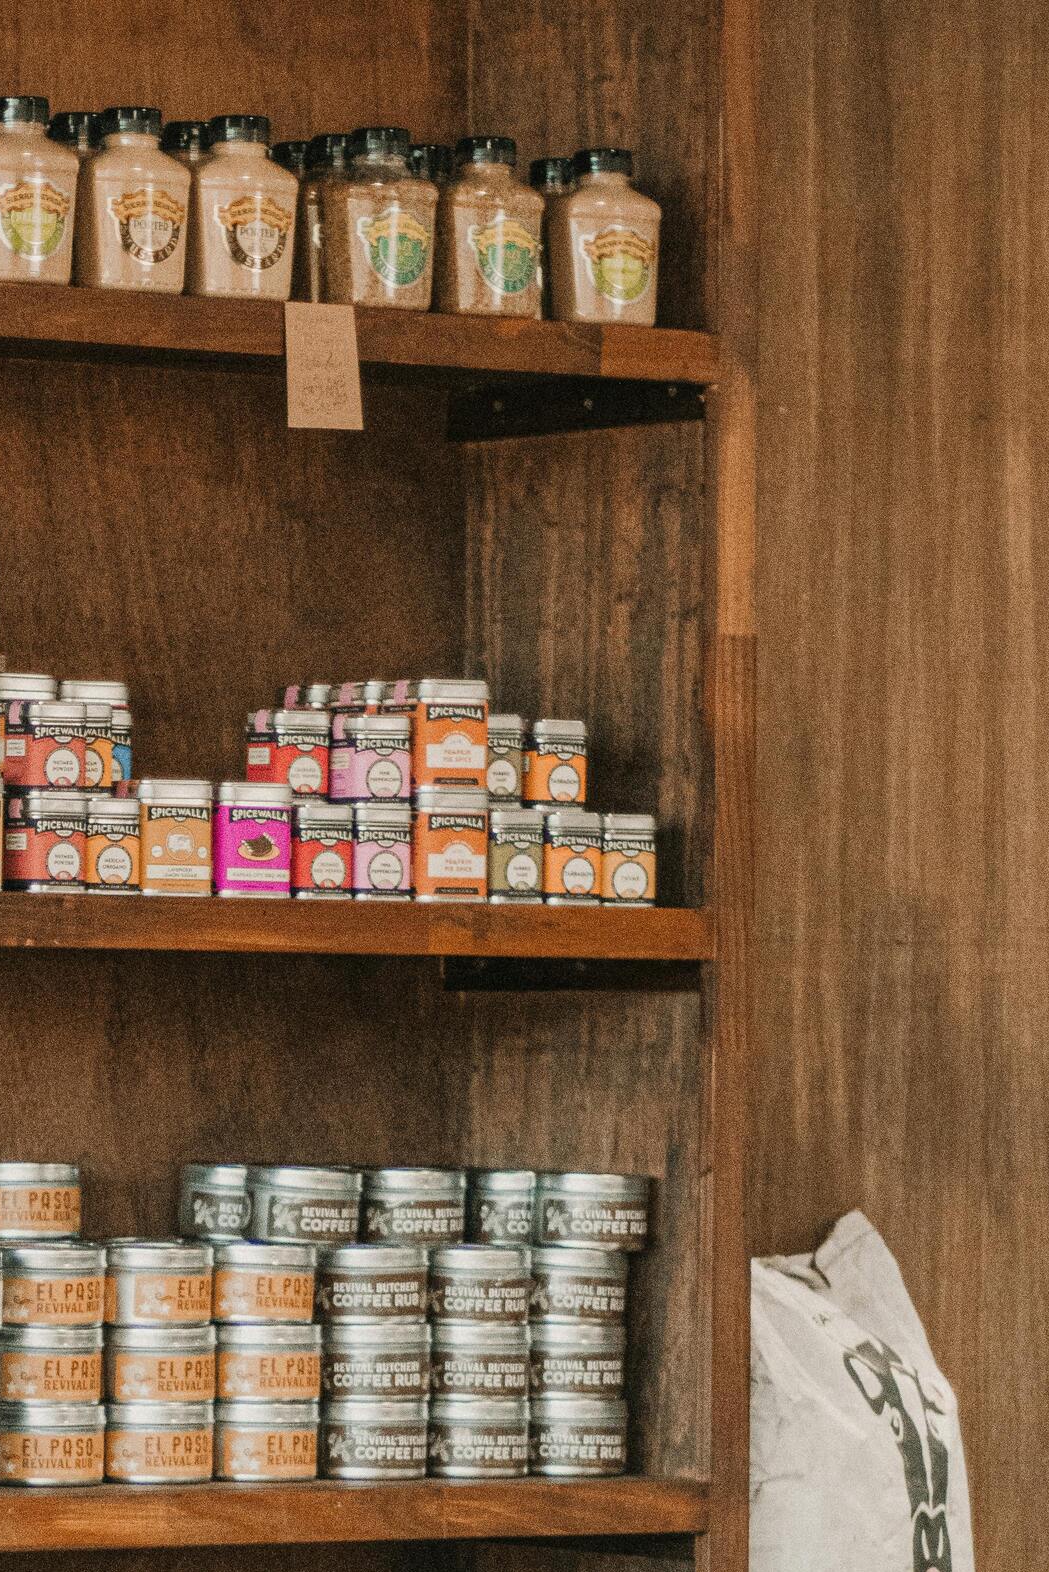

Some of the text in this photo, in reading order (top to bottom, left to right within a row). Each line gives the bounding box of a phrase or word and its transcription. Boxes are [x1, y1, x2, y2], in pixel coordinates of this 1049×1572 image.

[429, 706, 483, 718] SPICEWALLA
[151, 807, 208, 820] SPICEWALLA
[232, 809, 288, 821] SPICEWALLA
[431, 816, 483, 828] SPICEWALLA
[1, 1192, 20, 1209] EL
[392, 1208, 432, 1219] REVIVAL
[391, 1219, 444, 1232] COFFEE
[36, 1283, 56, 1301] EL
[256, 1276, 274, 1295] EL
[333, 1283, 373, 1294] REVIVAL
[445, 1286, 485, 1298] REVIVAL
[333, 1294, 392, 1307] COFFEE
[444, 1299, 501, 1312] COFFEE
[43, 1360, 64, 1377] EL
[157, 1361, 176, 1377] EL
[334, 1363, 374, 1373] REVIVAL
[444, 1361, 485, 1372] REVIVAL
[544, 1360, 584, 1370] REVIVAL
[334, 1374, 392, 1387] COFFEE
[444, 1373, 501, 1387] COFFEE
[543, 1371, 600, 1385] COFFEE
[541, 1433, 580, 1444] REVIVAL
[22, 1438, 45, 1457] EL
[144, 1437, 165, 1454] EL
[539, 1446, 596, 1458] COFFEE
